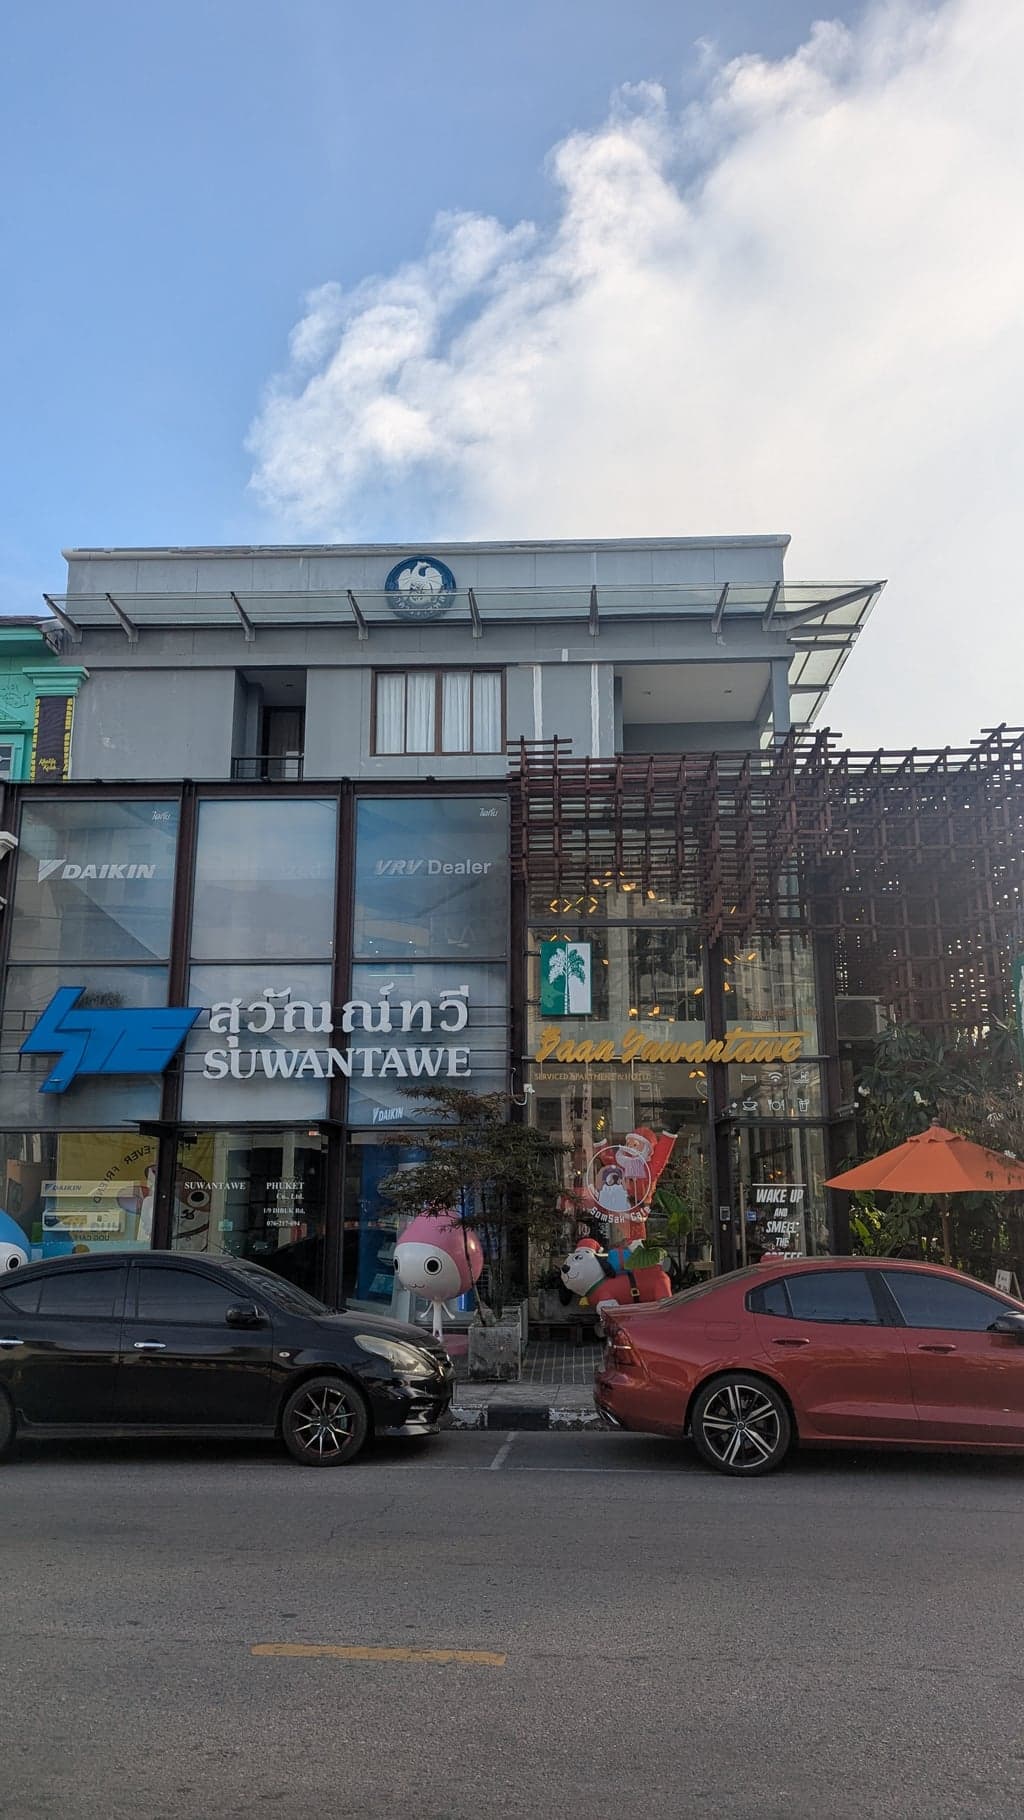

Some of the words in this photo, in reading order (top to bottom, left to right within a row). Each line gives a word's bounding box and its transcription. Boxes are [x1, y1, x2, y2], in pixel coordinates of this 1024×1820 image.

[61, 864, 156, 879] DAIKIN
[375, 859, 423, 875] VRV
[428, 859, 492, 875] Dealer
[202, 1047, 472, 1079] SUWANTAWE
[378, 1107, 404, 1122] DAIKIN
[184, 1181, 246, 1190] SUWANTAWE
[266, 1181, 305, 1190] PHUKET
[756, 1189, 787, 1203] WAKE
[790, 1189, 804, 1203] UP
[773, 1207, 788, 1218] AND
[766, 1221, 797, 1233] SMELL
[775, 1237, 790, 1247] THE
